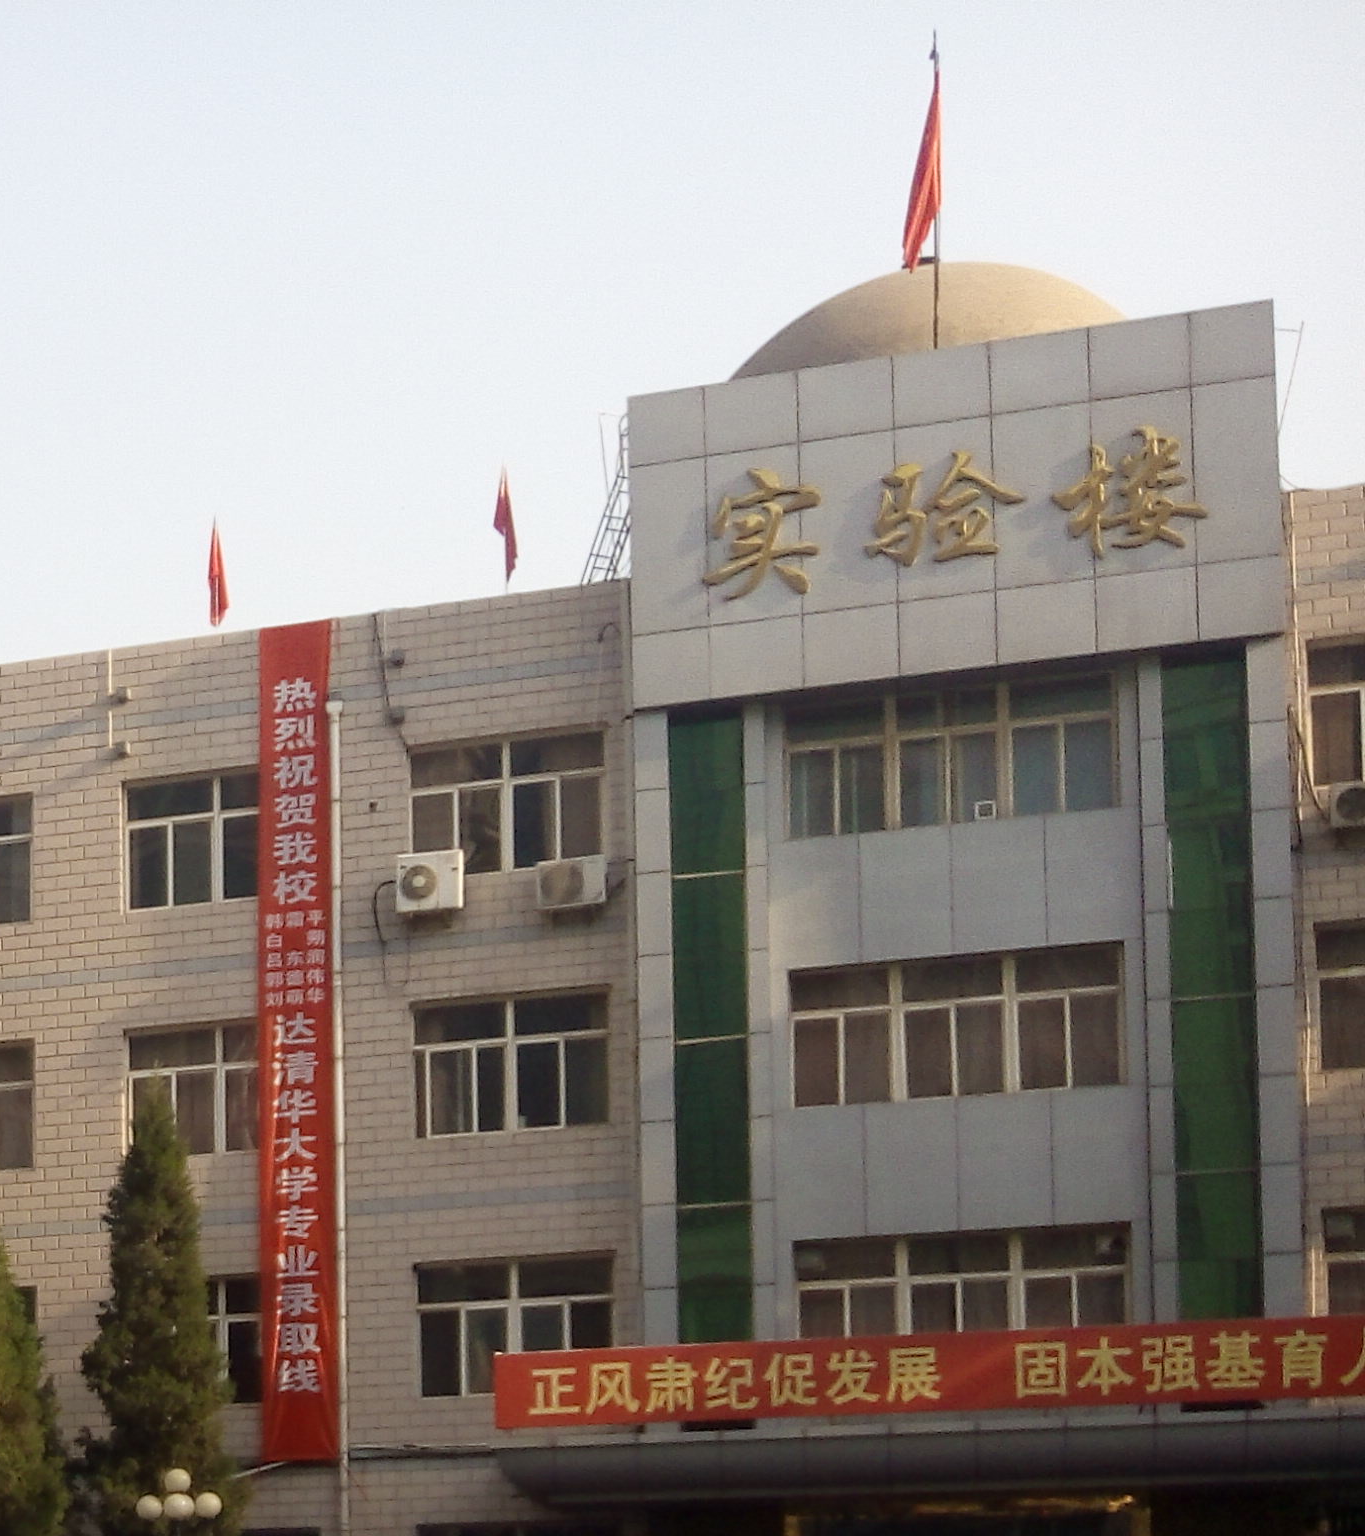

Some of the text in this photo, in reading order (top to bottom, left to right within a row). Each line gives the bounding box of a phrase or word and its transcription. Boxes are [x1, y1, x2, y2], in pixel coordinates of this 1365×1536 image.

[701, 425, 1207, 601] 实验楼
[272, 678, 320, 1395] 热烈祝贺我校 达清华大学专业录取线
[529, 1347, 943, 1417] 正风肃纪促发展
